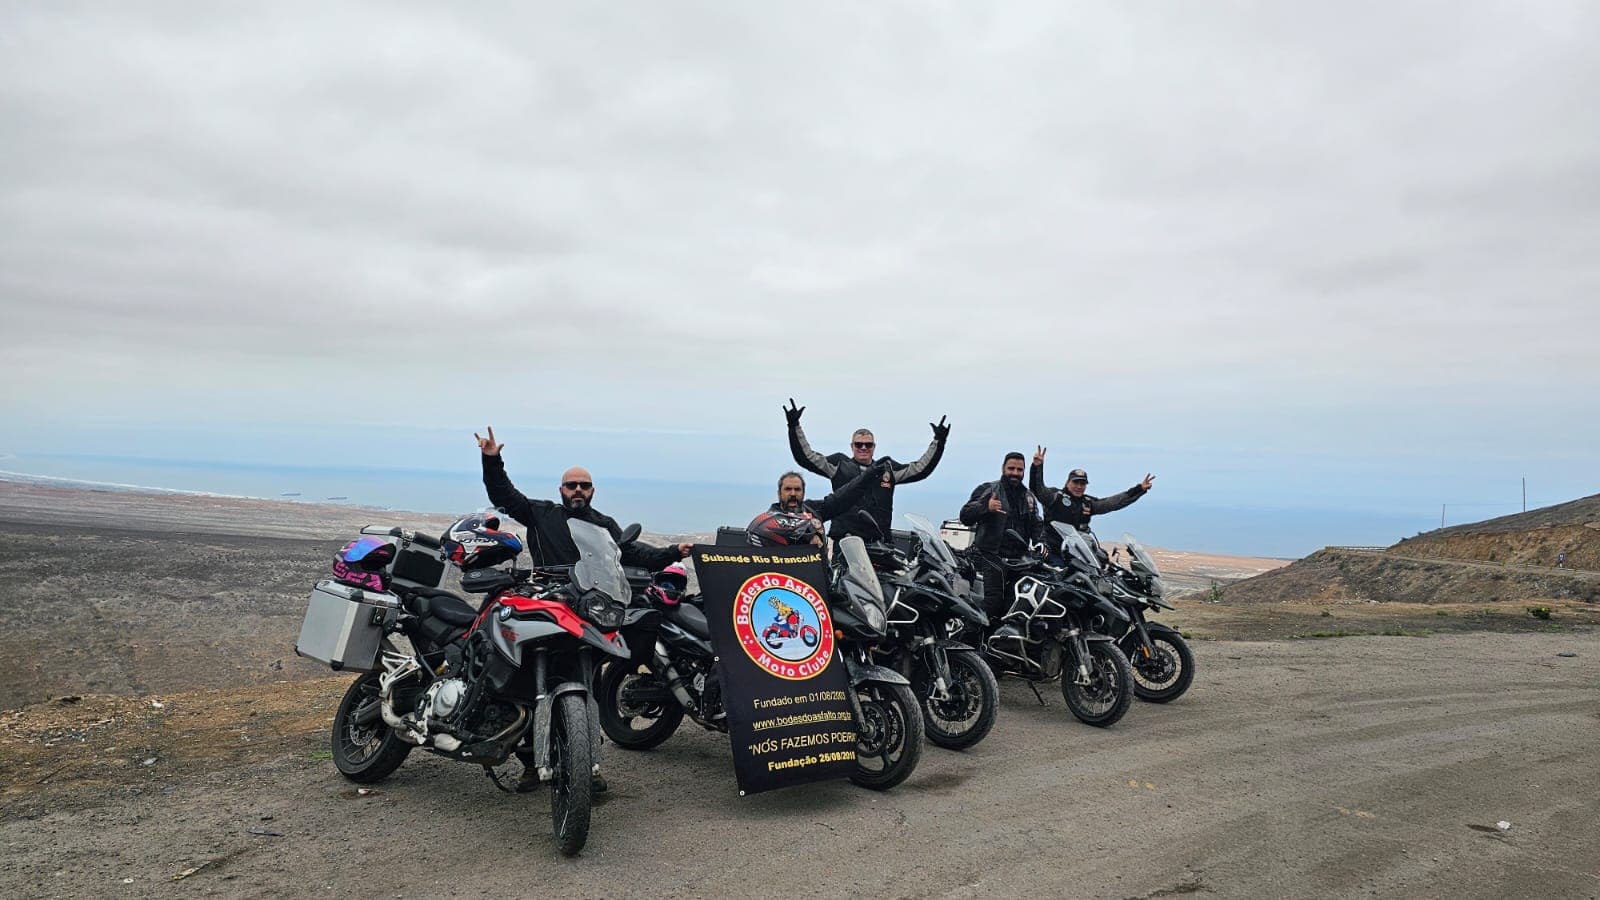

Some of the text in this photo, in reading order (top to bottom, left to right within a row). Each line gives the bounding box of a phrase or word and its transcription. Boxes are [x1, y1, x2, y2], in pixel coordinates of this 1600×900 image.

[701, 553, 750, 563] Subsede
[752, 555, 770, 563] Rio
[737, 576, 827, 625] Bodes do Asfalto
[758, 650, 829, 677] Moto Clube
[753, 695, 793, 709] Fundado
[795, 695, 808, 704] em
[781, 733, 830, 750] FAZEMOS
[768, 755, 818, 772] Fundação
